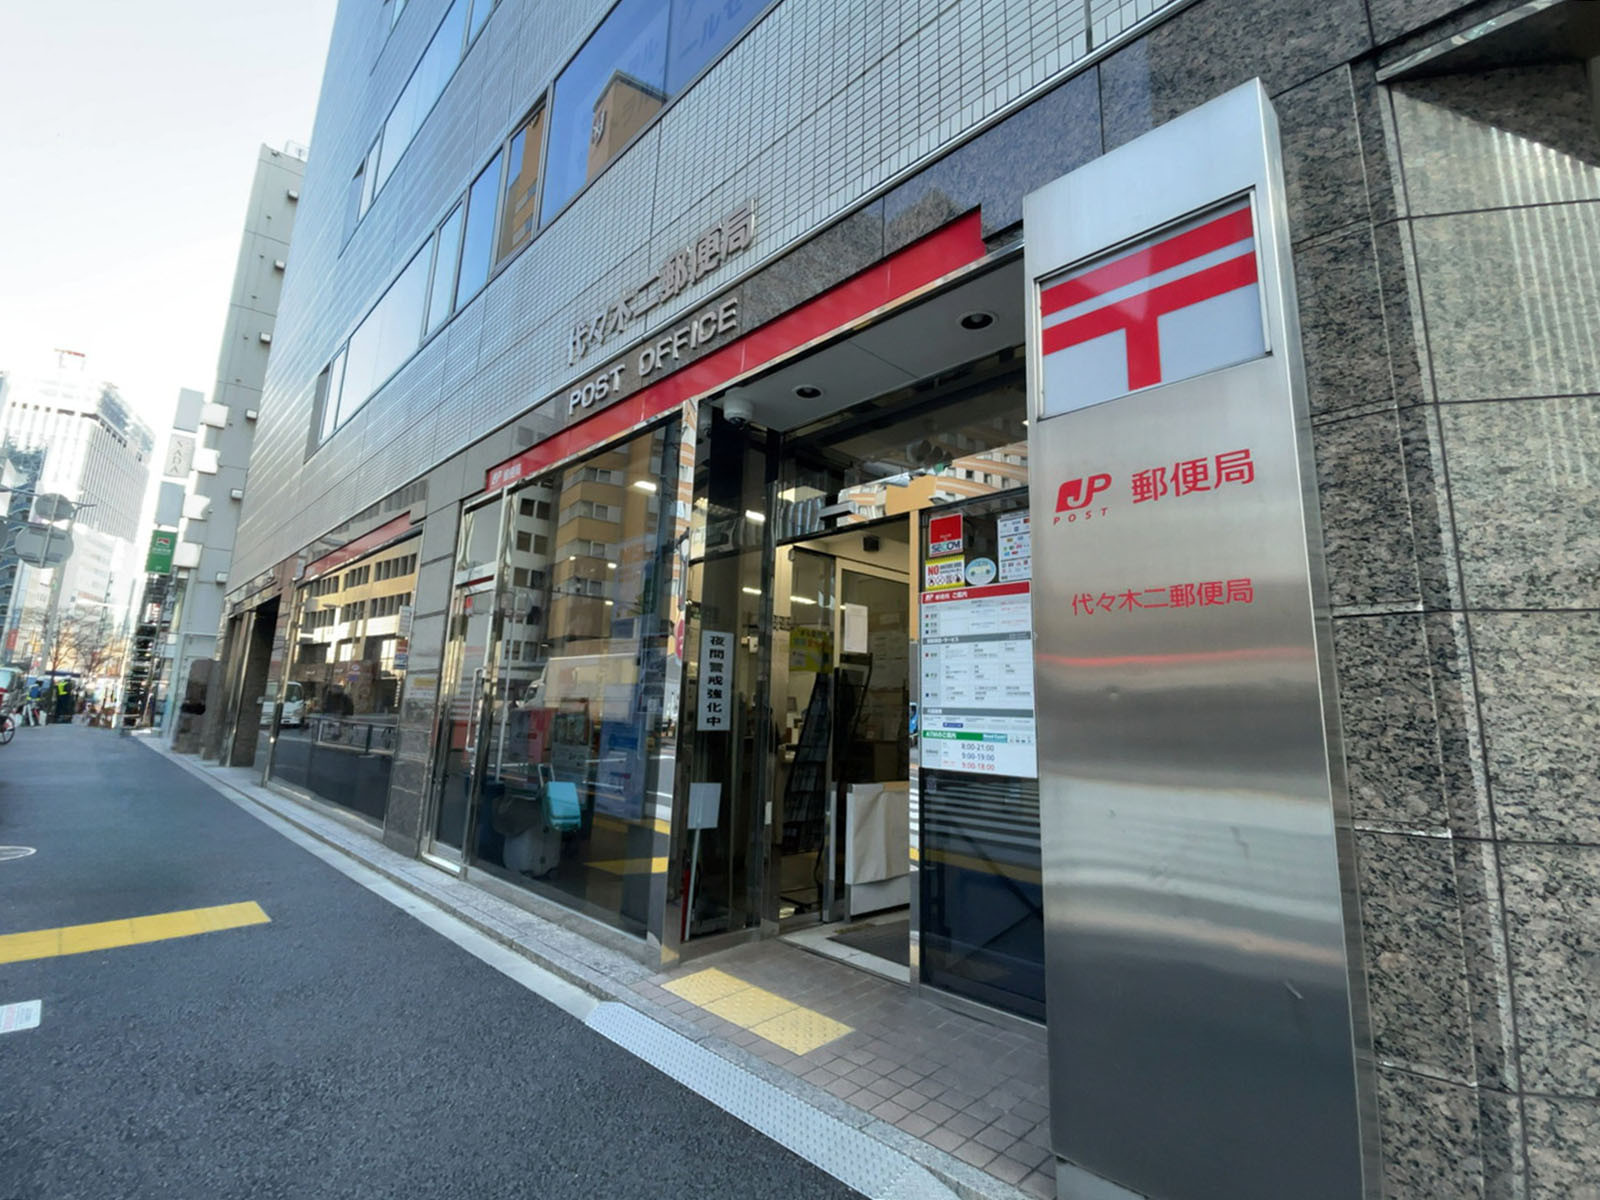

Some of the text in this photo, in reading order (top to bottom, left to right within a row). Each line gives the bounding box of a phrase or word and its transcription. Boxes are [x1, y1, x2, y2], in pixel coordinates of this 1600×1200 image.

[568, 199, 757, 366] 代々木二郵便局
[569, 297, 739, 416] POST OFFICE
[1131, 448, 1255, 504] 郵便局
[1052, 507, 1109, 526] POST
[927, 565, 939, 576] NO
[931, 541, 961, 553] SECOM
[1071, 578, 1254, 616] 代々木二郵便局
[706, 636, 726, 727] 夜間警戒強化中
